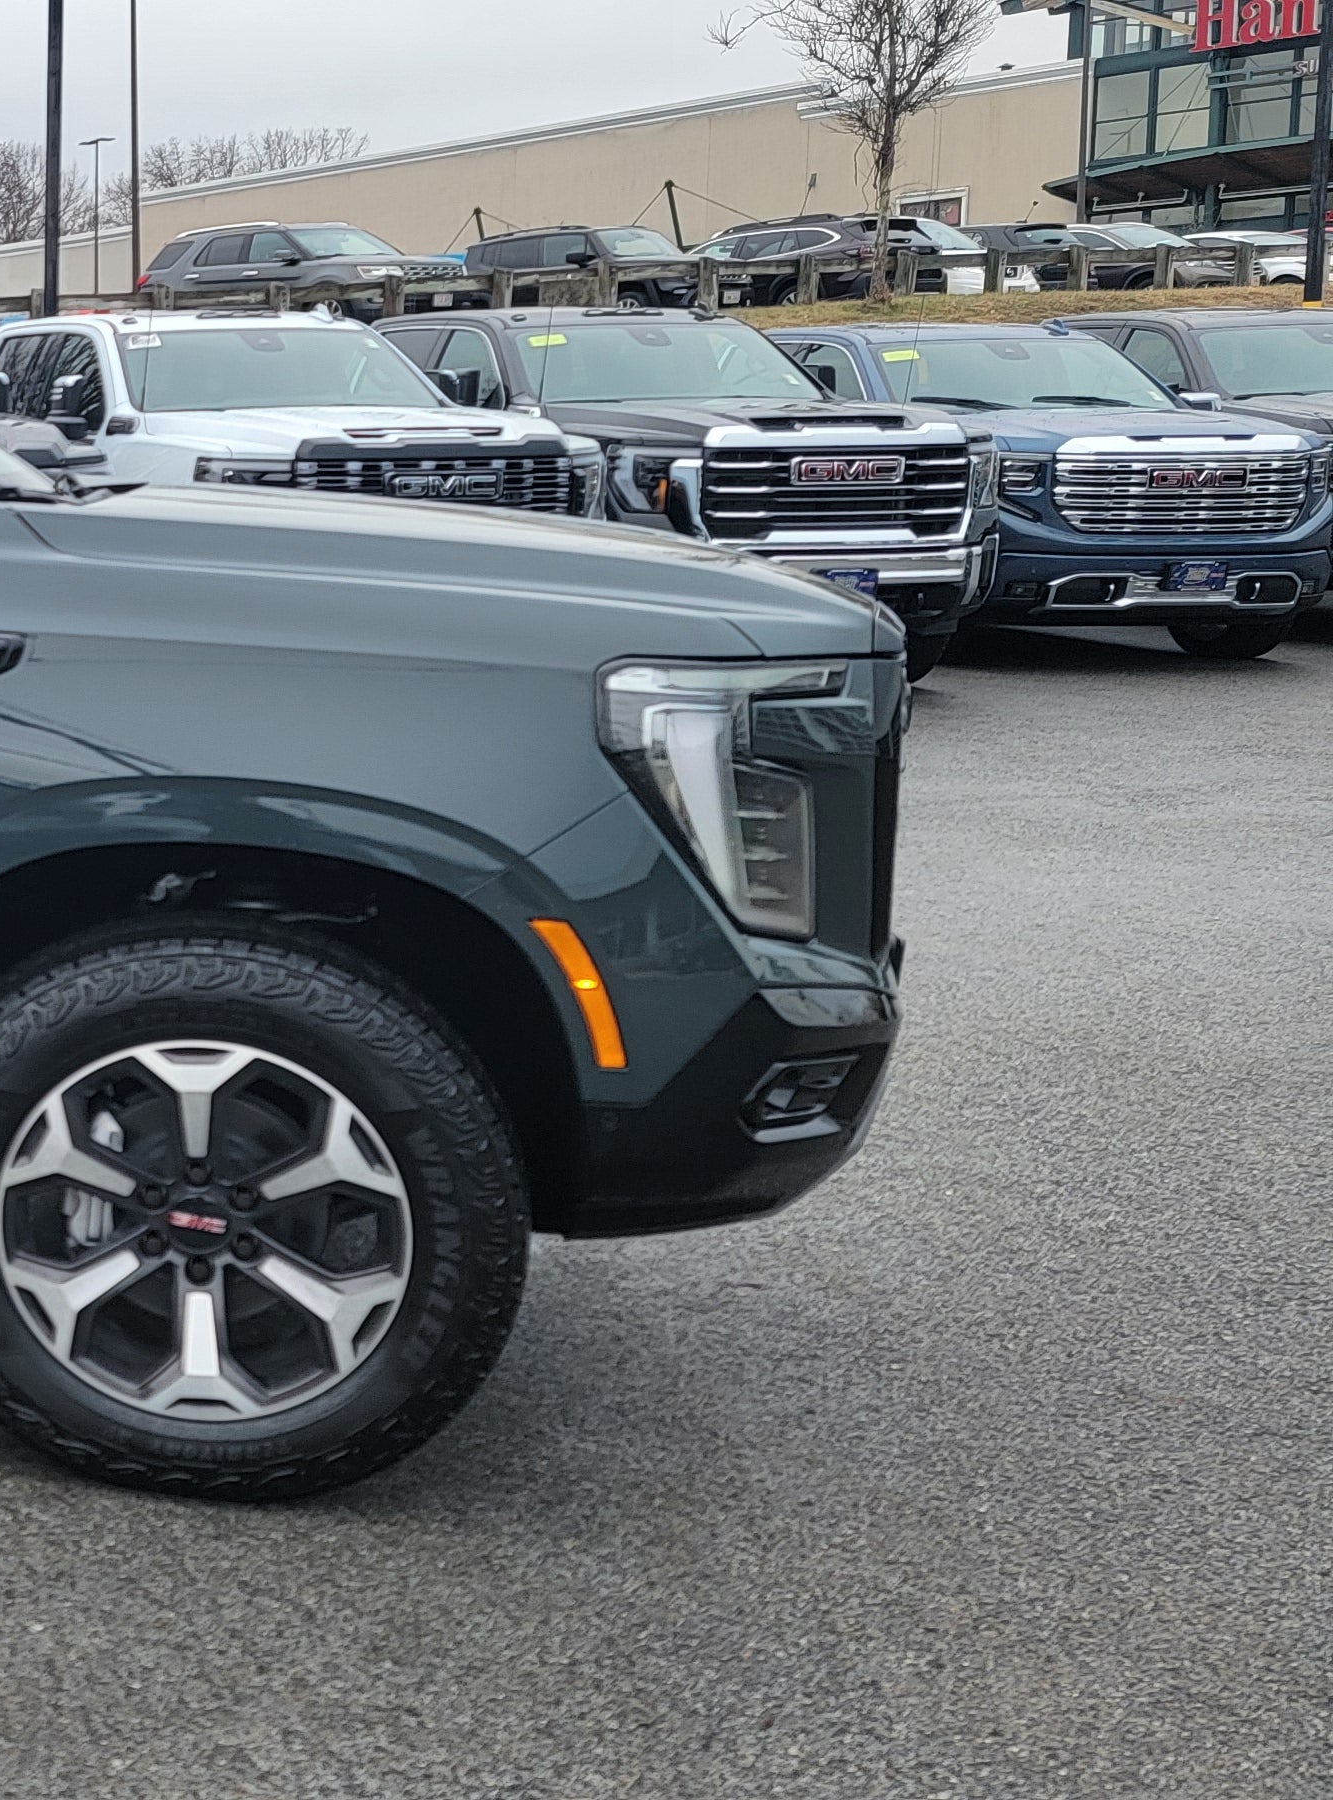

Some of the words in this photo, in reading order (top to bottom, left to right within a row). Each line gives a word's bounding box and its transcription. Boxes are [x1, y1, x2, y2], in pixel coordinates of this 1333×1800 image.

[800, 460, 899, 481] GMC
[1152, 469, 1244, 488] GMC
[394, 474, 498, 497] GMC
[402, 1125, 464, 1371] WRANGLER
